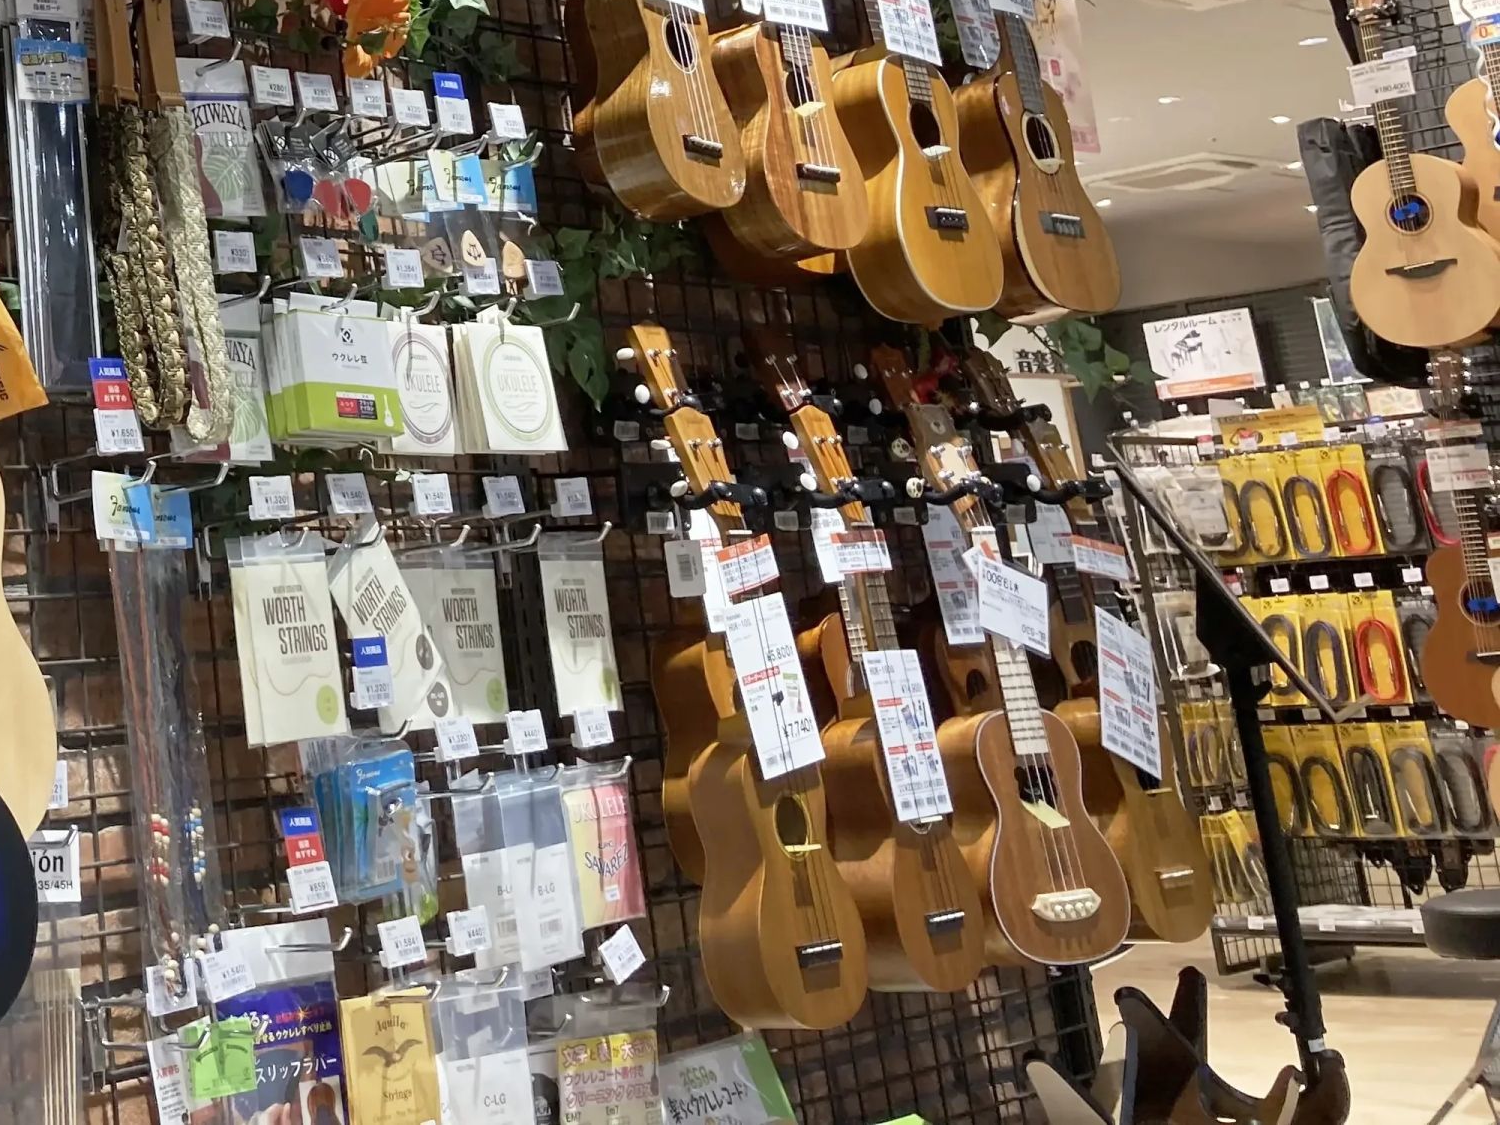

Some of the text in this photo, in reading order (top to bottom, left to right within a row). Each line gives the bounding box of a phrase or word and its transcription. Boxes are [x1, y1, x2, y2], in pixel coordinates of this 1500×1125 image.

[191, 102, 247, 131] KIWAYA
[1154, 315, 1217, 333] レンタルルーム
[332, 353, 368, 364] ウクレレ弦
[404, 374, 442, 393] UKULELE
[500, 372, 538, 393] UKULELE
[262, 594, 306, 625] WORTH
[352, 574, 387, 626] WORTH
[372, 588, 407, 638] STRINGS
[442, 597, 478, 623] WORTH
[555, 588, 589, 612] WORTH
[278, 623, 328, 655] STRINGS
[456, 623, 495, 650] STRINGS
[567, 613, 606, 640] STRINGS
[783, 718, 810, 739] ¥7,740
[573, 795, 628, 824] UKULELE
[584, 842, 629, 878] SAVAREZ
[382, 1086, 413, 1102] Strings
[484, 1092, 507, 1107] C-LG
